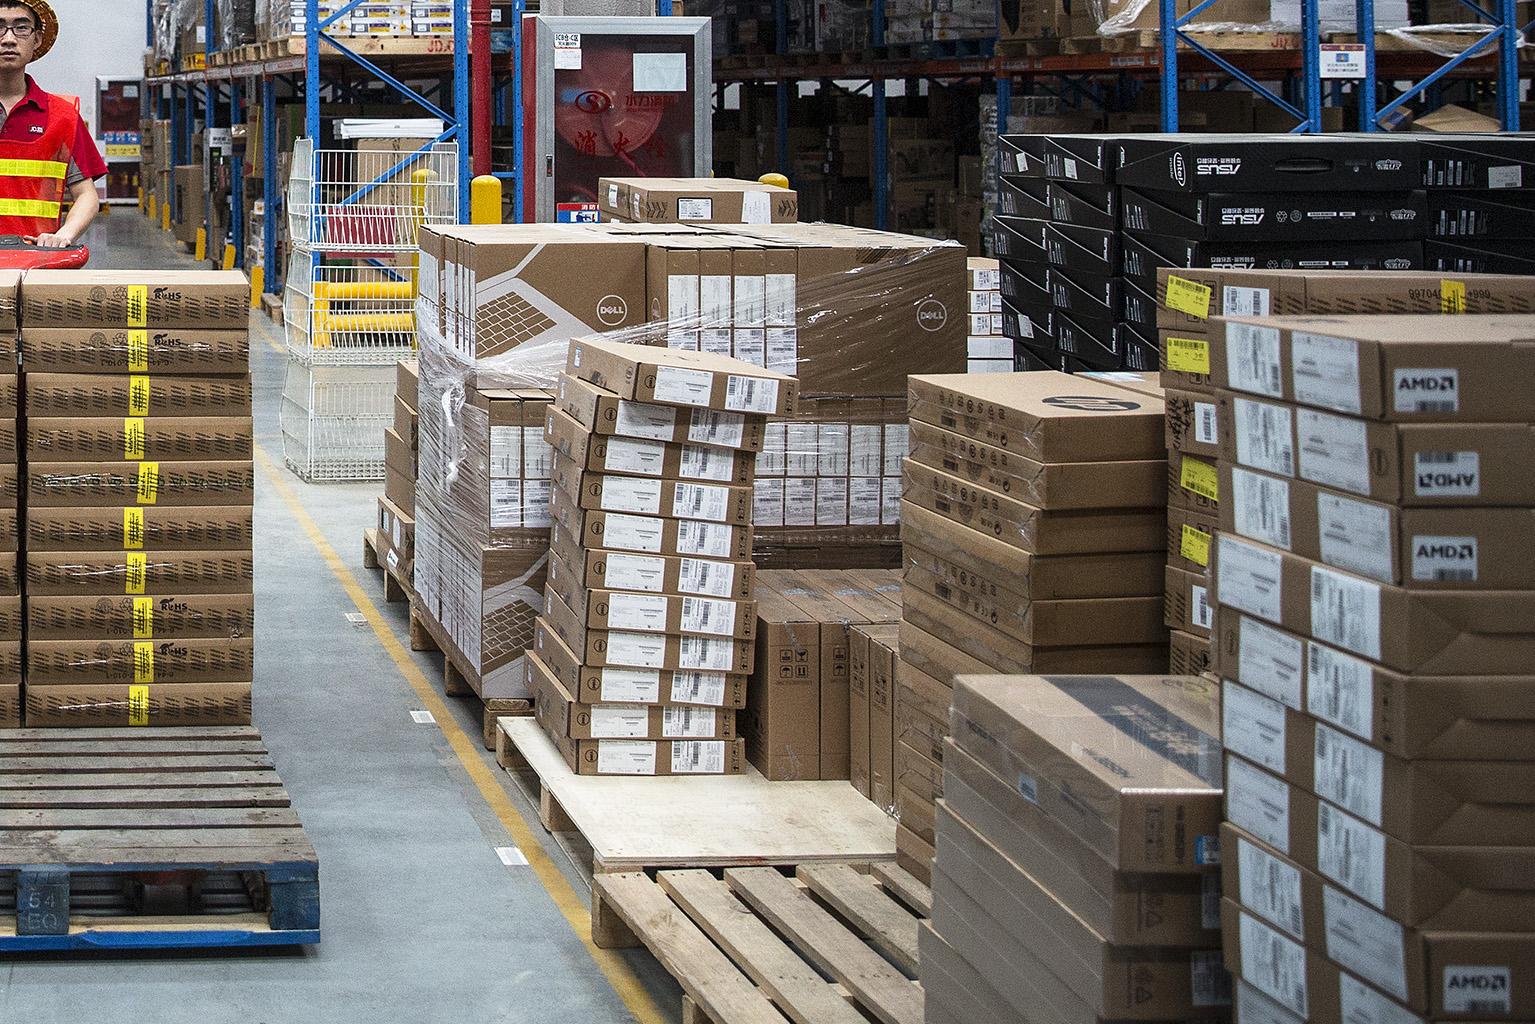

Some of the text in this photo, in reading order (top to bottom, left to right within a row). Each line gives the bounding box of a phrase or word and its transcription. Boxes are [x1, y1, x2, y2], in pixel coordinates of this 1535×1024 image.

[1196, 164, 1241, 175] ASUS
[1221, 214, 1264, 225] ASUS
[598, 304, 625, 319] DELL
[918, 311, 945, 322] DELL
[1398, 377, 1440, 391] AMD
[1435, 474, 1475, 487] AMD
[1416, 544, 1458, 559] AMD
[1448, 975, 1491, 990] AMD
